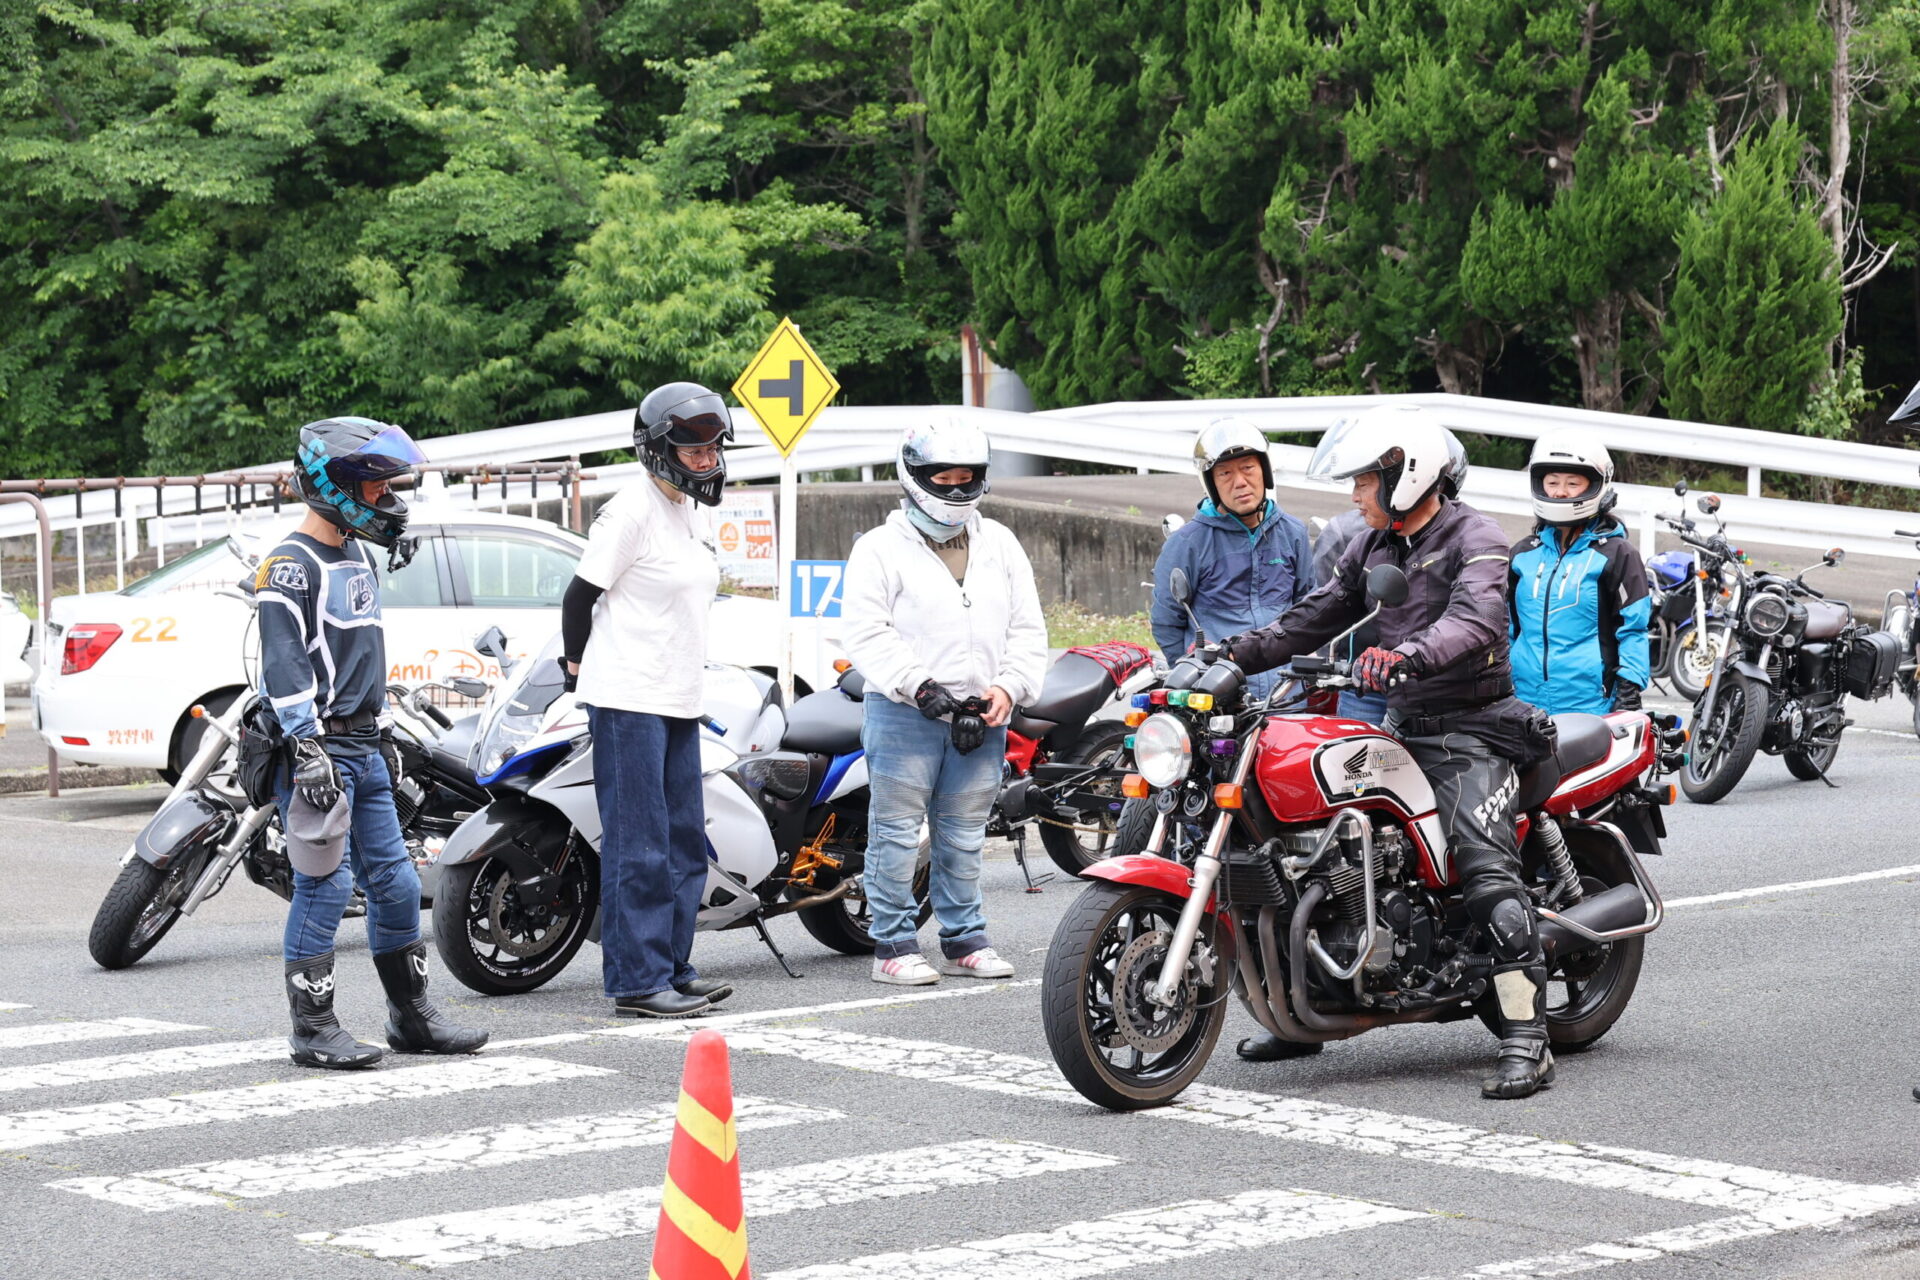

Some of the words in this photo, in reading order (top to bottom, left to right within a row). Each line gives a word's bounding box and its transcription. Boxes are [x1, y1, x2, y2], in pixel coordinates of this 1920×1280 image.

[797, 565, 842, 613] 17
[131, 616, 178, 643] 22
[1344, 771, 1373, 781] HONDA
[477, 955, 508, 977] SUZUKI
